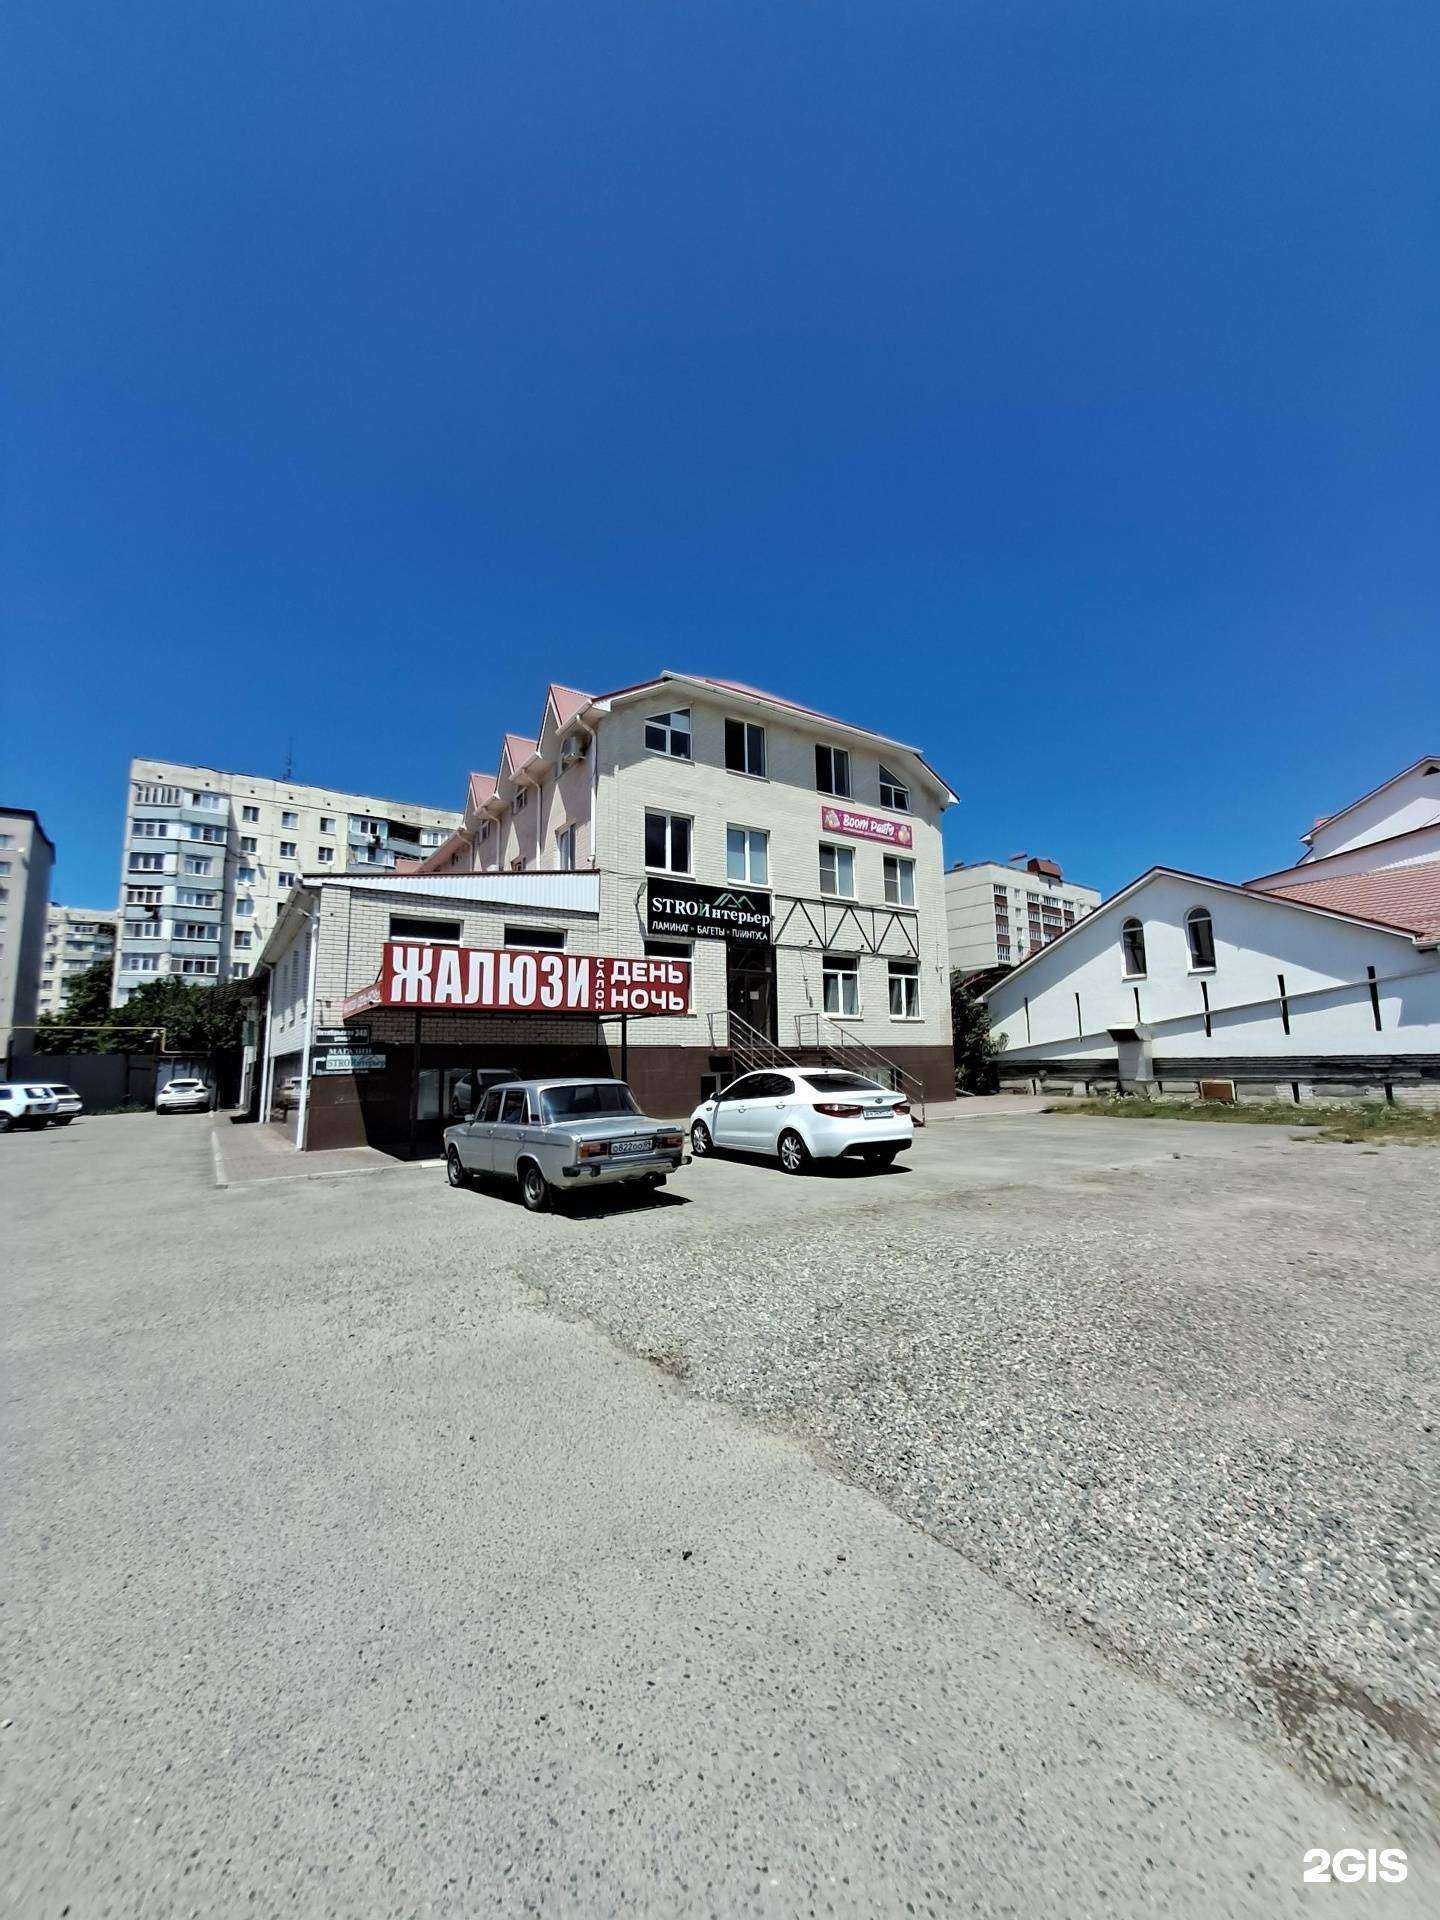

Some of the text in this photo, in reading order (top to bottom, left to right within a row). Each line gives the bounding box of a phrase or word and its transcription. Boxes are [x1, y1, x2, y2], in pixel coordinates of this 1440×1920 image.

[652, 920, 768, 940] ЛАМИНАТ БАГЕТЫ ПЛИНТУСА
[391, 946, 590, 1008] ЖАЛЮЗИ
[595, 959, 605, 1010] САЛОН
[610, 960, 684, 986] ДЕНЬ
[610, 988, 685, 1011] НОЧЬ
